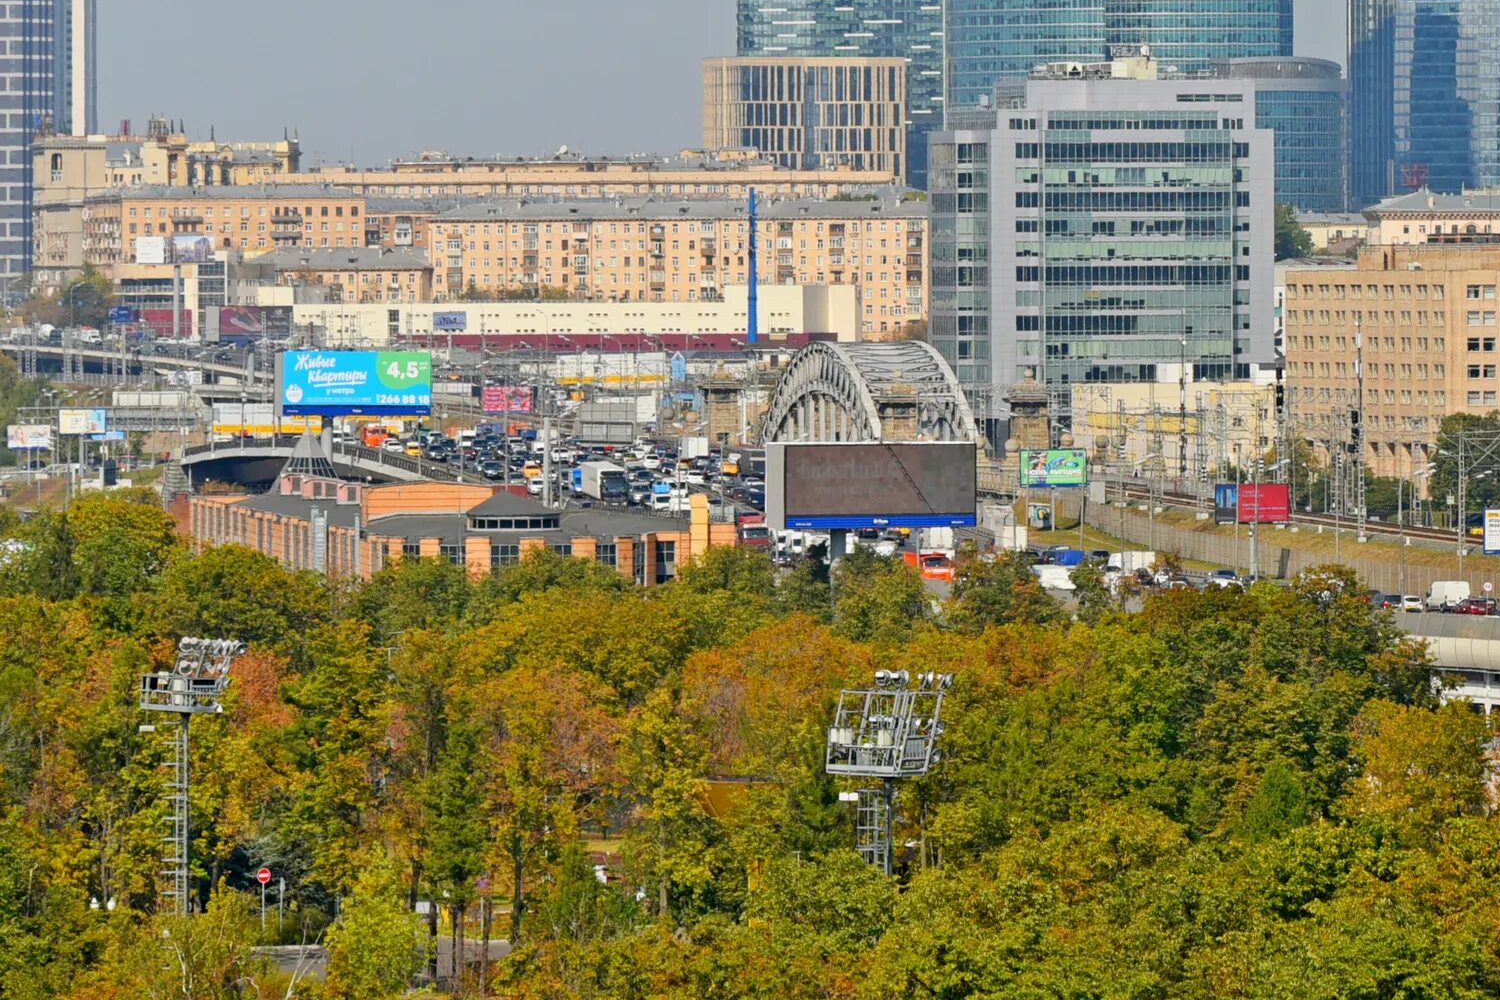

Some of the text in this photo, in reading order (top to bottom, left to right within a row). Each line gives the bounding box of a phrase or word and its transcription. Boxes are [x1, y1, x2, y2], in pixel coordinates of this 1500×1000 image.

[294, 353, 336, 371] Живые
[308, 370, 368, 385] Квартиры
[386, 361, 419, 379] 4,5
[326, 388, 355, 396] у метро
[380, 394, 400, 404] 266
[402, 394, 415, 404] 88
[418, 394, 430, 404] 18
